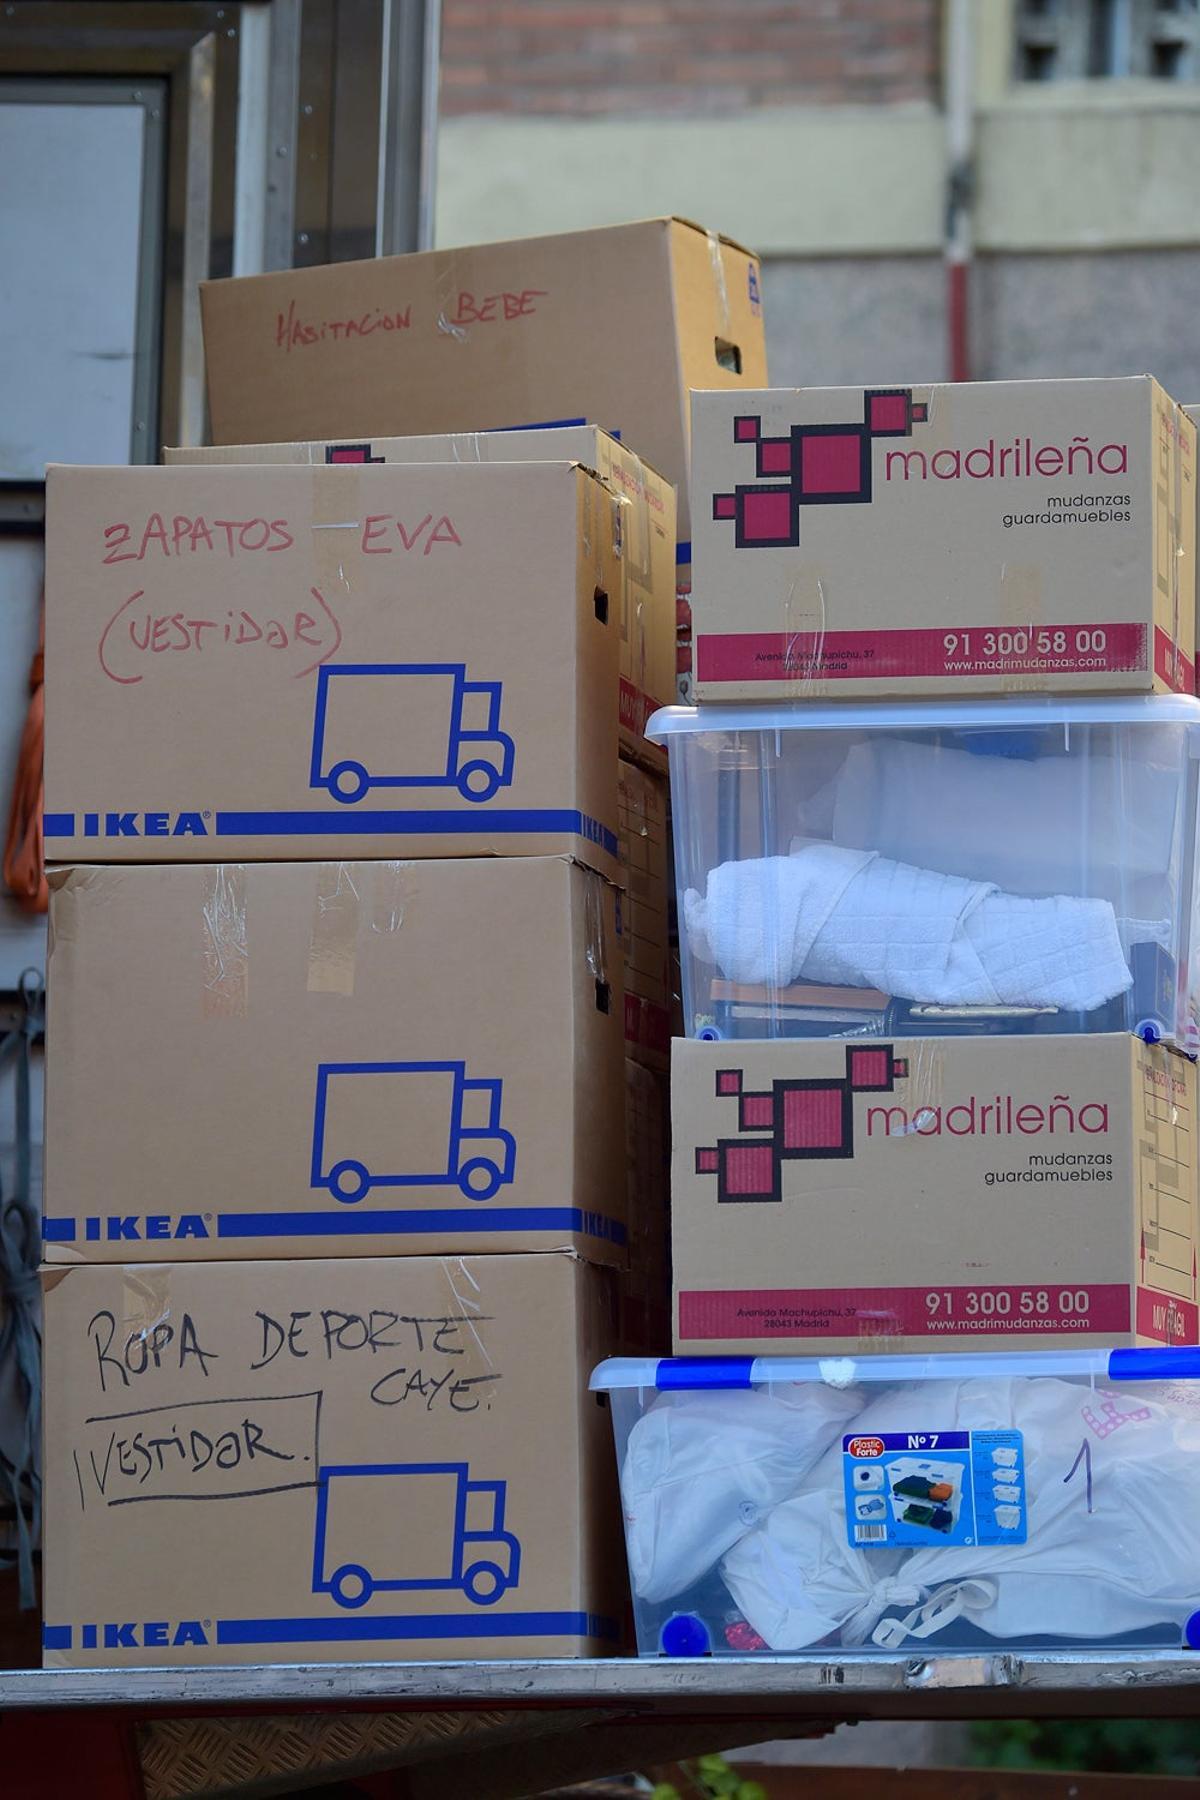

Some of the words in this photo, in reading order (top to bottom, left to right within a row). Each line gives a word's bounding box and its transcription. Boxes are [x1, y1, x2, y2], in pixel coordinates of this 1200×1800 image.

[452, 290, 549, 325] BEBE
[885, 436, 1128, 482] madrileña
[1047, 493, 1131, 508] mudanzas
[1003, 509, 1131, 529] guardamuebles
[102, 512, 294, 564] ZAPATOS
[360, 514, 463, 556] EVA
[943, 633, 970, 656] 91
[983, 631, 1028, 655] 300
[1036, 630, 1067, 654] 58
[1075, 629, 1107, 653] 00
[943, 656, 1107, 671] www.madrimudanzas.com
[866, 1095, 1109, 1138] madrileña
[1028, 1152, 1113, 1166] mudanzas
[984, 1168, 1113, 1184] guardamuebles
[924, 1291, 954, 1315] 91
[965, 1291, 1010, 1315] 300
[1018, 1290, 1050, 1314] 58
[1058, 1290, 1090, 1314] 00
[736, 1308, 777, 1318] Avenida
[845, 1308, 857, 1316] 37
[764, 1320, 792, 1328] 28043
[794, 1318, 830, 1328] Madrid
[925, 1317, 1090, 1331] www.madrimudanzas.com
[88, 1310, 219, 1392] ROPA
[250, 1310, 496, 1370] DEPORTE
[853, 1439, 881, 1451] Plastic
[929, 1434, 939, 1449] 7
[856, 1449, 879, 1458] Forte
[1064, 1438, 1093, 1514] 1
